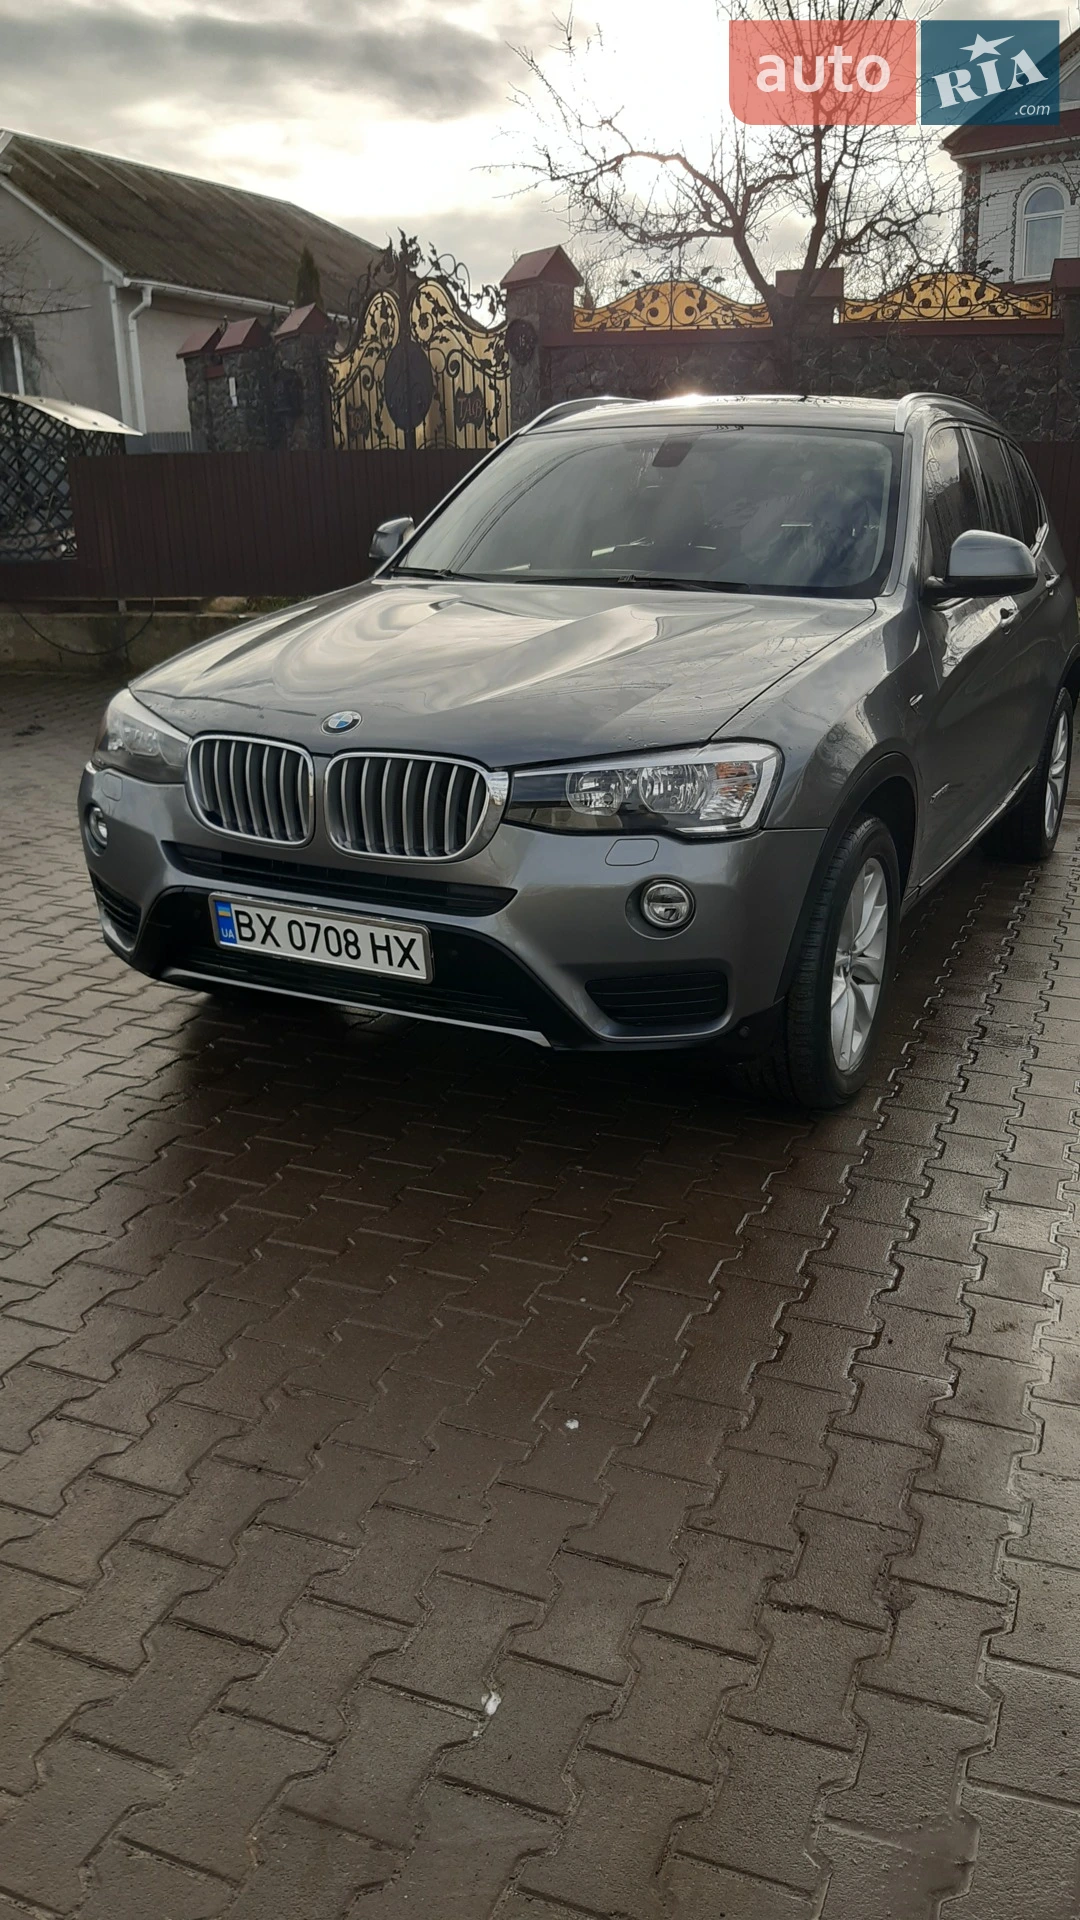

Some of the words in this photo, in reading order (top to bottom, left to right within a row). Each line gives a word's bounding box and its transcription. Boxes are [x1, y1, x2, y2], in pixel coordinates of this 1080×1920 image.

[222, 927, 235, 939] UA
[234, 910, 281, 948] BX
[287, 919, 362, 960] 0708
[369, 932, 420, 971] HX
